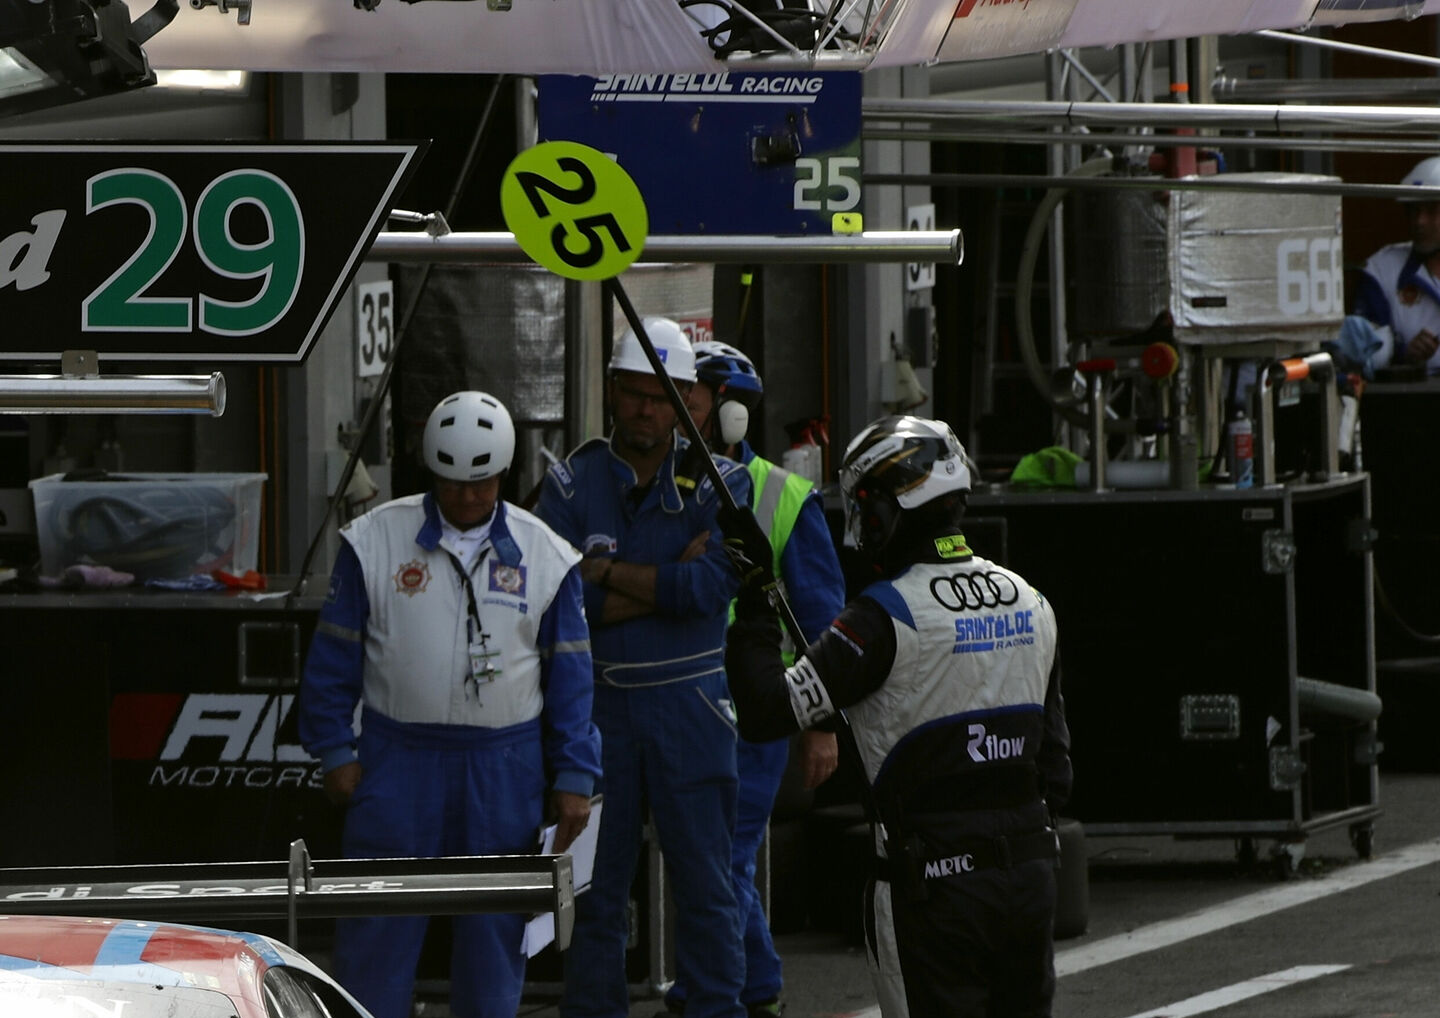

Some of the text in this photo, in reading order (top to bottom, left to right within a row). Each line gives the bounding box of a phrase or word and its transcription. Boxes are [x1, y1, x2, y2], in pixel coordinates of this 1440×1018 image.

[740, 76, 823, 93] RACING
[793, 156, 861, 211] 25
[515, 157, 632, 268] 25
[80, 167, 306, 337] 29
[362, 293, 390, 365] 35
[996, 637, 1034, 649] RACING
[967, 723, 1026, 763] Rflow
[925, 853, 975, 880] MRTC
